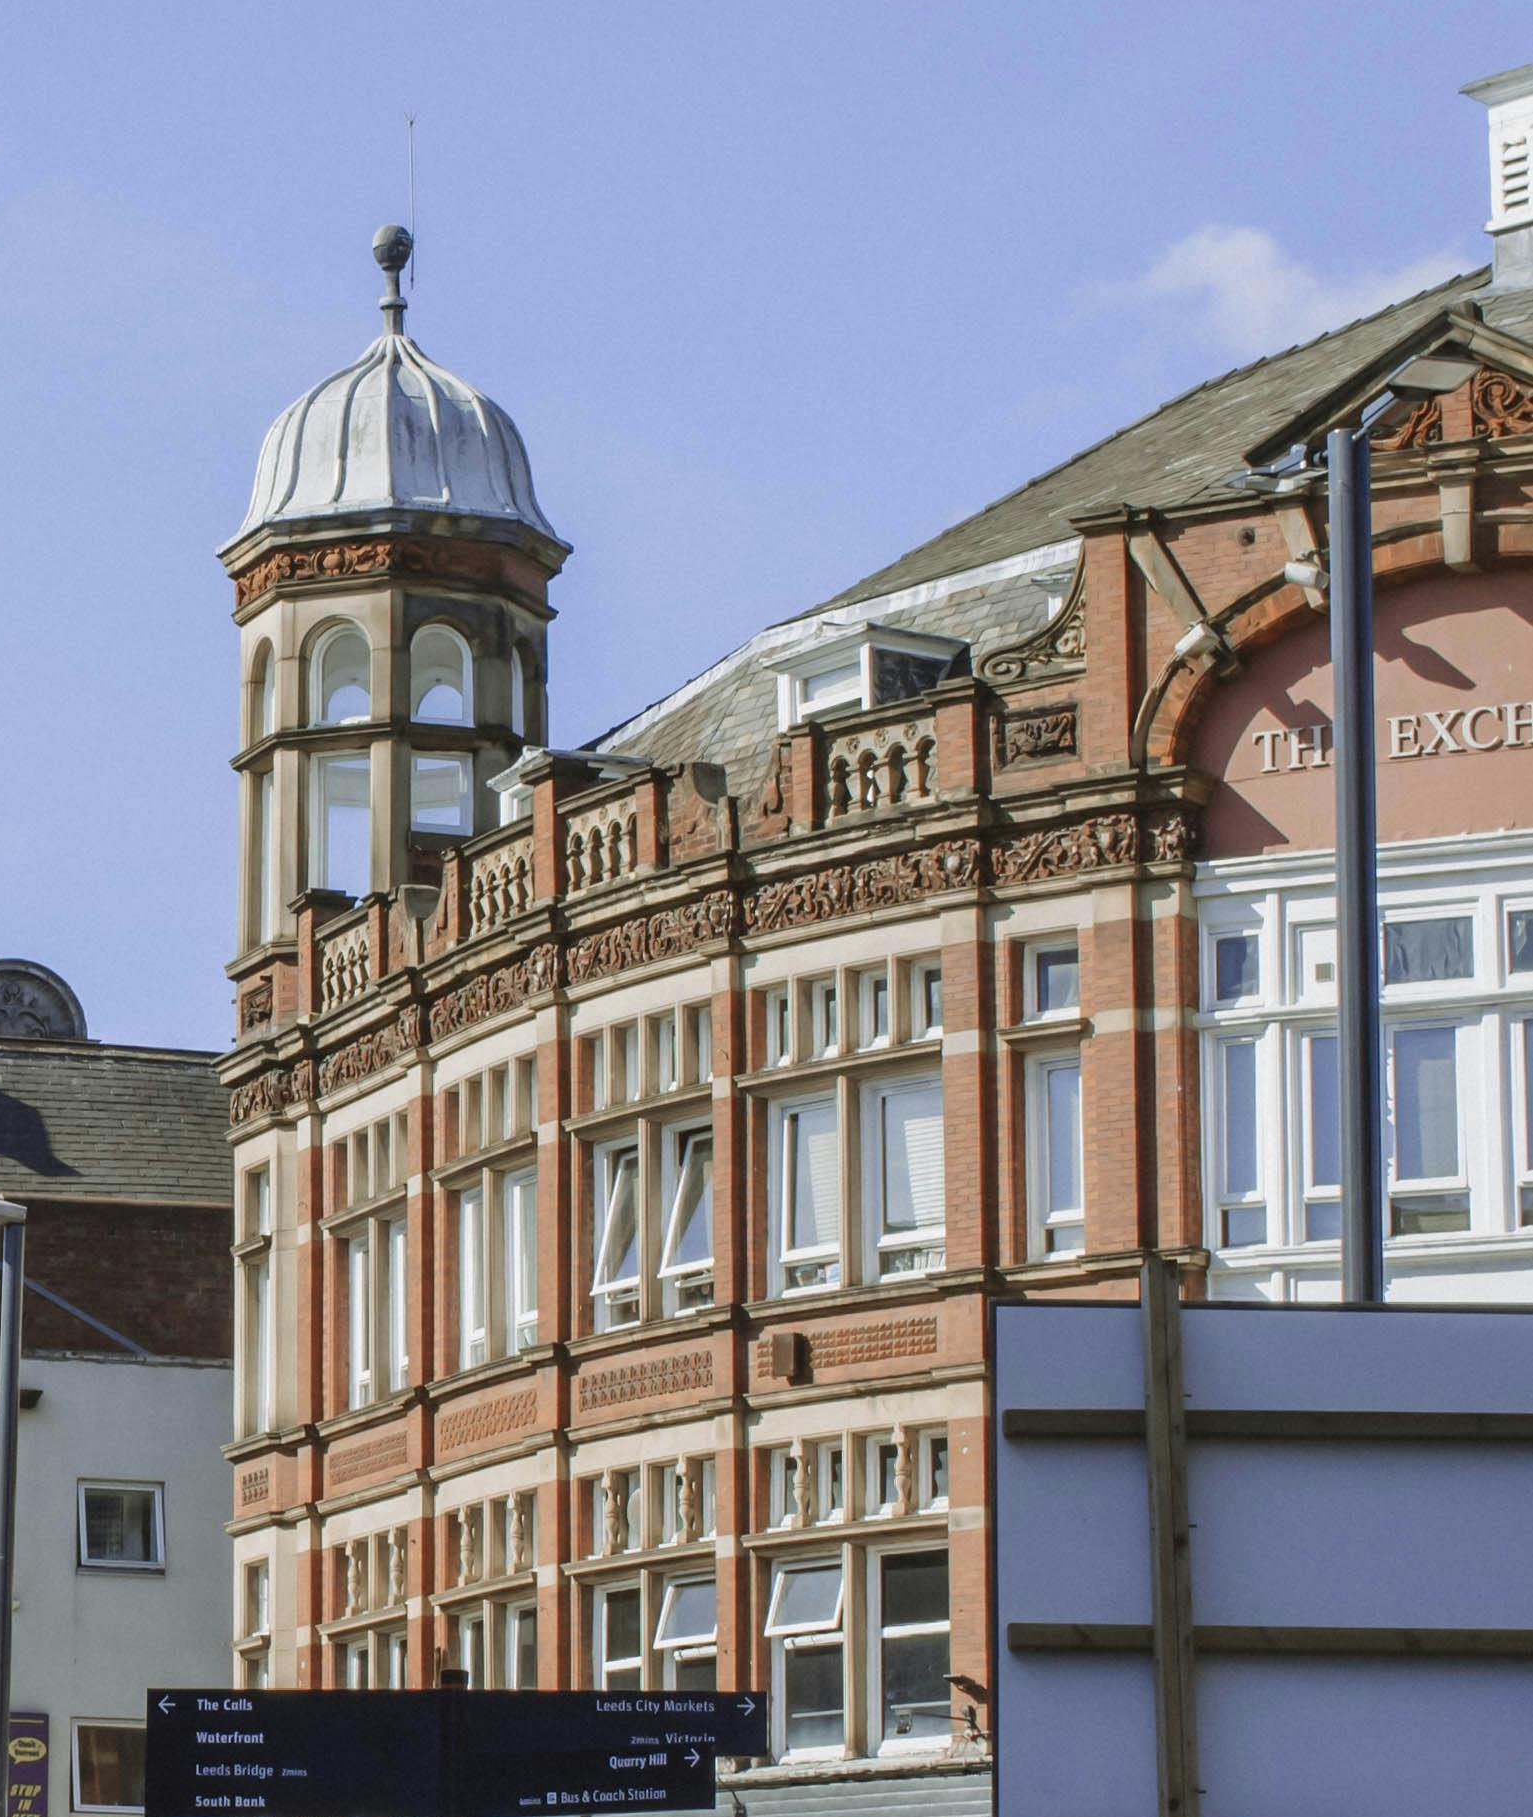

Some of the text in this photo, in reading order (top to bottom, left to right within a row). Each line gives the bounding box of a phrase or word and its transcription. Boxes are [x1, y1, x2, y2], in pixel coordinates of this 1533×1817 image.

[1253, 702, 1533, 773] TH EXCH
[197, 1698, 253, 1711] The Calls
[596, 1699, 715, 1714] Leeds City Markets
[196, 1731, 264, 1744] Waterfront
[609, 1753, 667, 1769] Quarry Hill
[196, 1764, 308, 1779] Leeds Bridge 2mins
[10, 1784, 41, 1796] STOP
[561, 1792, 580, 1804] Bus
[582, 1790, 590, 1802] &
[593, 1789, 625, 1802] Coach
[627, 1787, 666, 1801] Station
[18, 1799, 32, 1811] IN
[196, 1796, 266, 1808] South Bank
